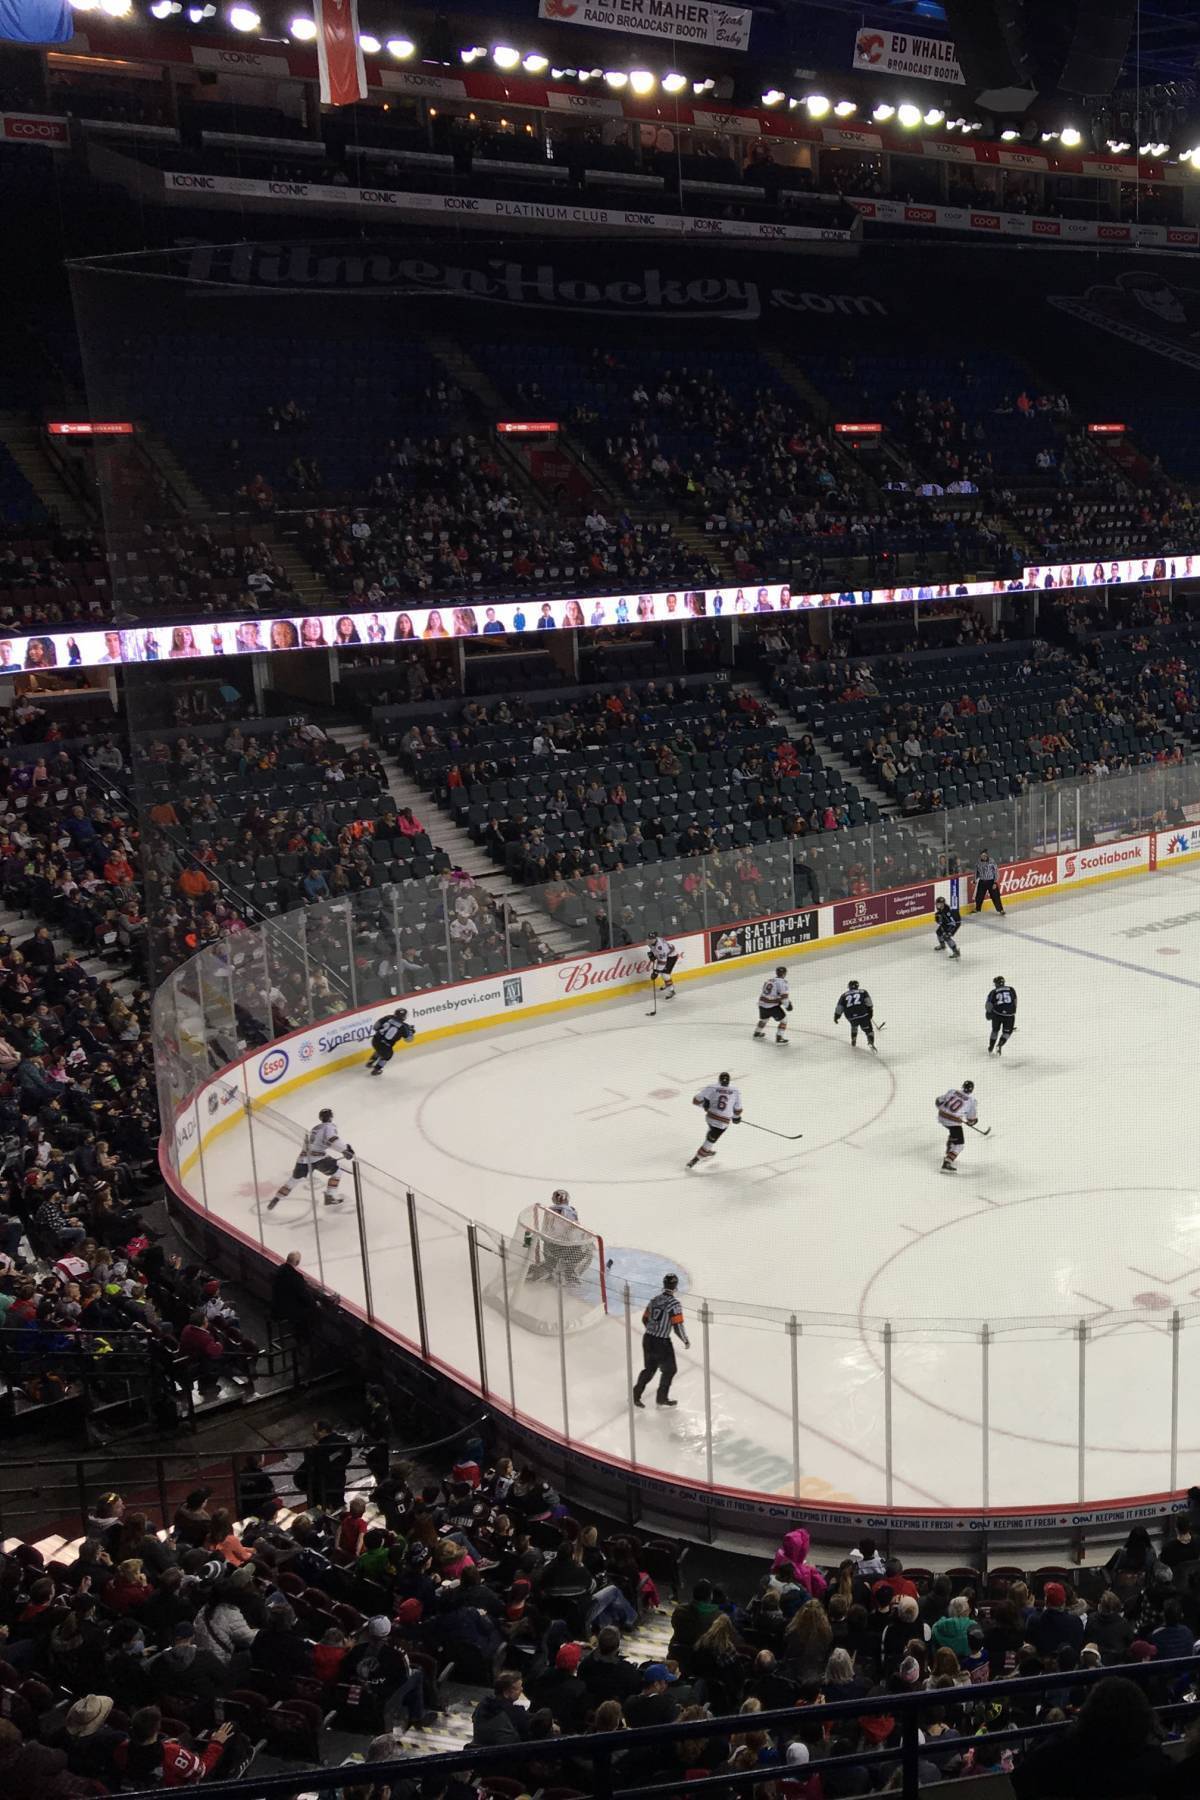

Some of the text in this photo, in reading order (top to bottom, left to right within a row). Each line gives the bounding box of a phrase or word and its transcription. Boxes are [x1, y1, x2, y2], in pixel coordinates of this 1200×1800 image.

[583, 8, 708, 40] RADIO BROADCAST BOOTH
[649, 0, 709, 24] MAHER
[891, 35, 909, 54] ED
[887, 58, 960, 82] BROADCAST BOOTH
[12, 122, 61, 136] CO-OP
[173, 175, 215, 190] ICONIC
[269, 182, 308, 196] ICONIC
[360, 189, 397, 204] ICONIC
[444, 197, 480, 211] ICONIC
[495, 202, 568, 220] PLATINUM
[572, 209, 608, 223] CLUB
[908, 209, 934, 220] CO-OP
[974, 217, 998, 226] CO-OP
[1034, 223, 1059, 233] CO-OP
[1100, 228, 1128, 238] CO-OP
[1169, 232, 1195, 242] CO-OP
[1080, 846, 1142, 870] Scotiabank
[1000, 868, 1054, 894] Hortons
[745, 913, 812, 940] S-A-T-U-R-D-A-Y
[843, 917, 857, 927] EDGE
[858, 913, 880, 923] SCHOOL
[745, 933, 782, 954] NIGHT!
[412, 990, 502, 1018] homesbyavi.com
[845, 994, 862, 1006] 22
[995, 991, 1012, 1005] 25
[318, 1024, 374, 1053] Synergy
[263, 1058, 285, 1076] Esso
[716, 1094, 729, 1111] 6
[890, 1518, 920, 1530] KEEPING
[930, 1520, 954, 1530] FRESH
[993, 1519, 1023, 1529] KEEPING
[1033, 1517, 1057, 1528] FRESH
[1095, 1511, 1125, 1523] KEEPING
[1134, 1507, 1157, 1519] FRESH
